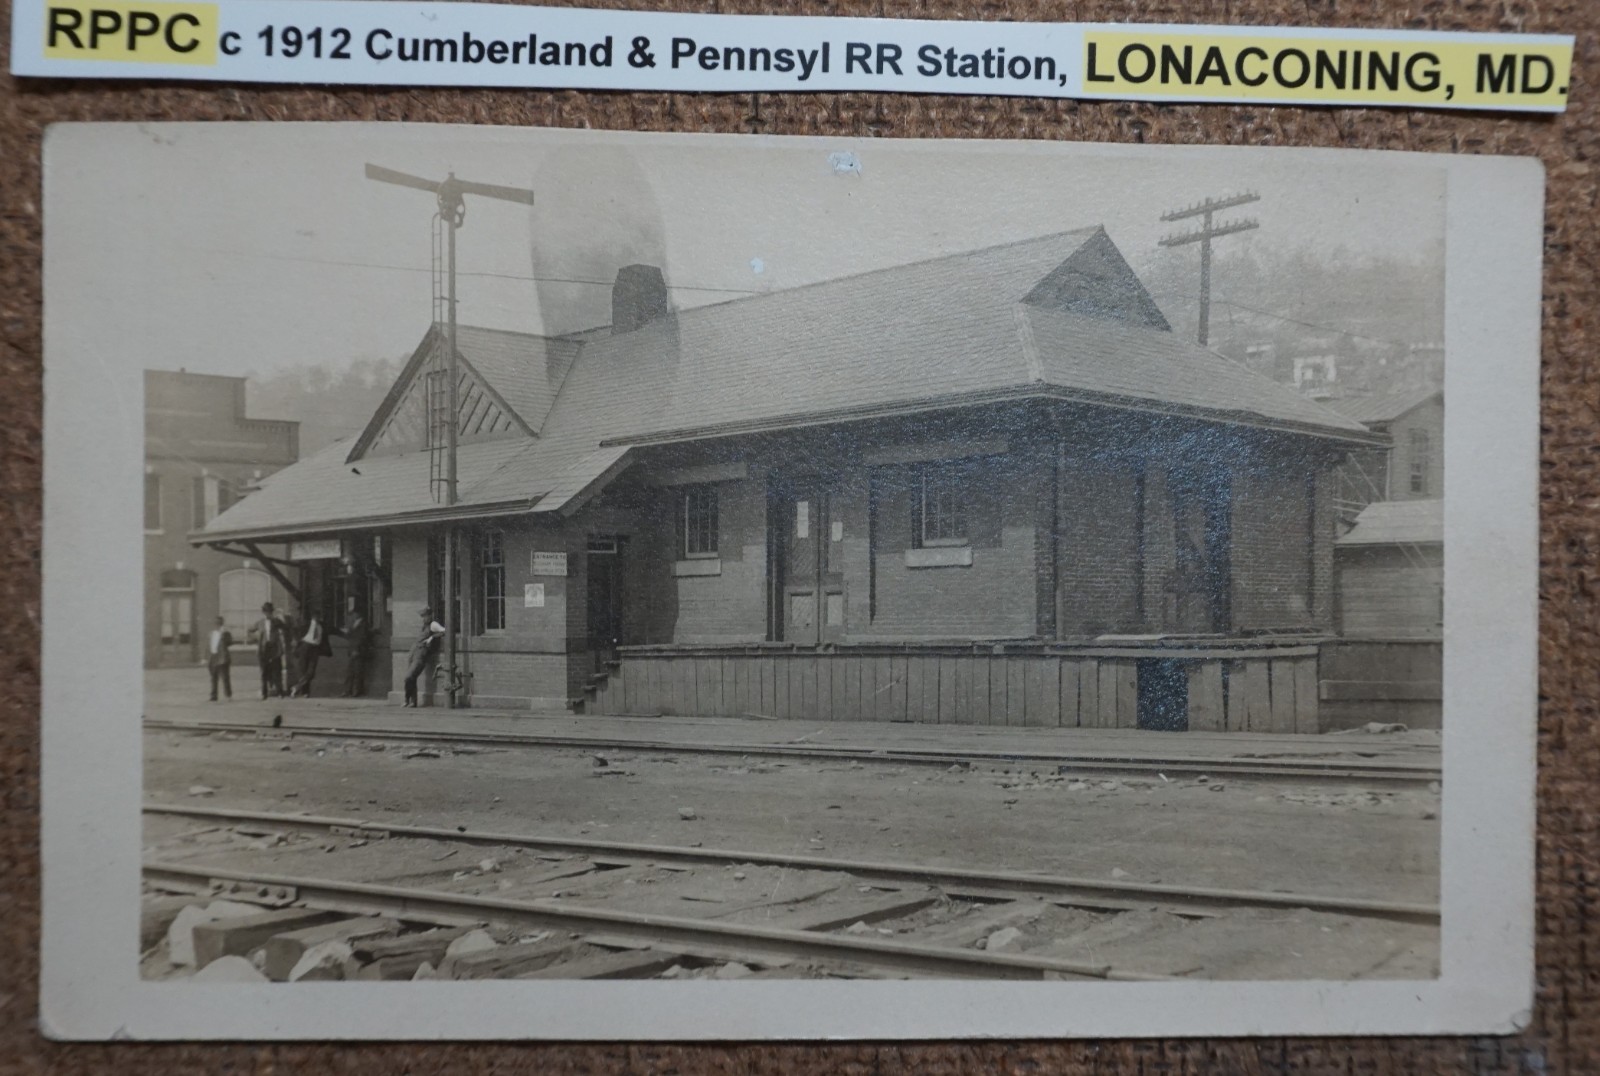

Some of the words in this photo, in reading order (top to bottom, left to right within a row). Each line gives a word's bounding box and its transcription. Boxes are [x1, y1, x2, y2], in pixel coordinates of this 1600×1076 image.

[47, 7, 201, 53] RPPC
[220, 32, 240, 55] c
[259, 26, 351, 59] 1912
[366, 29, 612, 66] Cumberland
[628, 37, 656, 68] &
[672, 38, 829, 80] Pennsyl
[846, 43, 902, 74] RR
[918, 45, 1066, 86] Station,
[1086, 43, 1454, 100] LONACONING,
[1477, 54, 1568, 95] MD.
